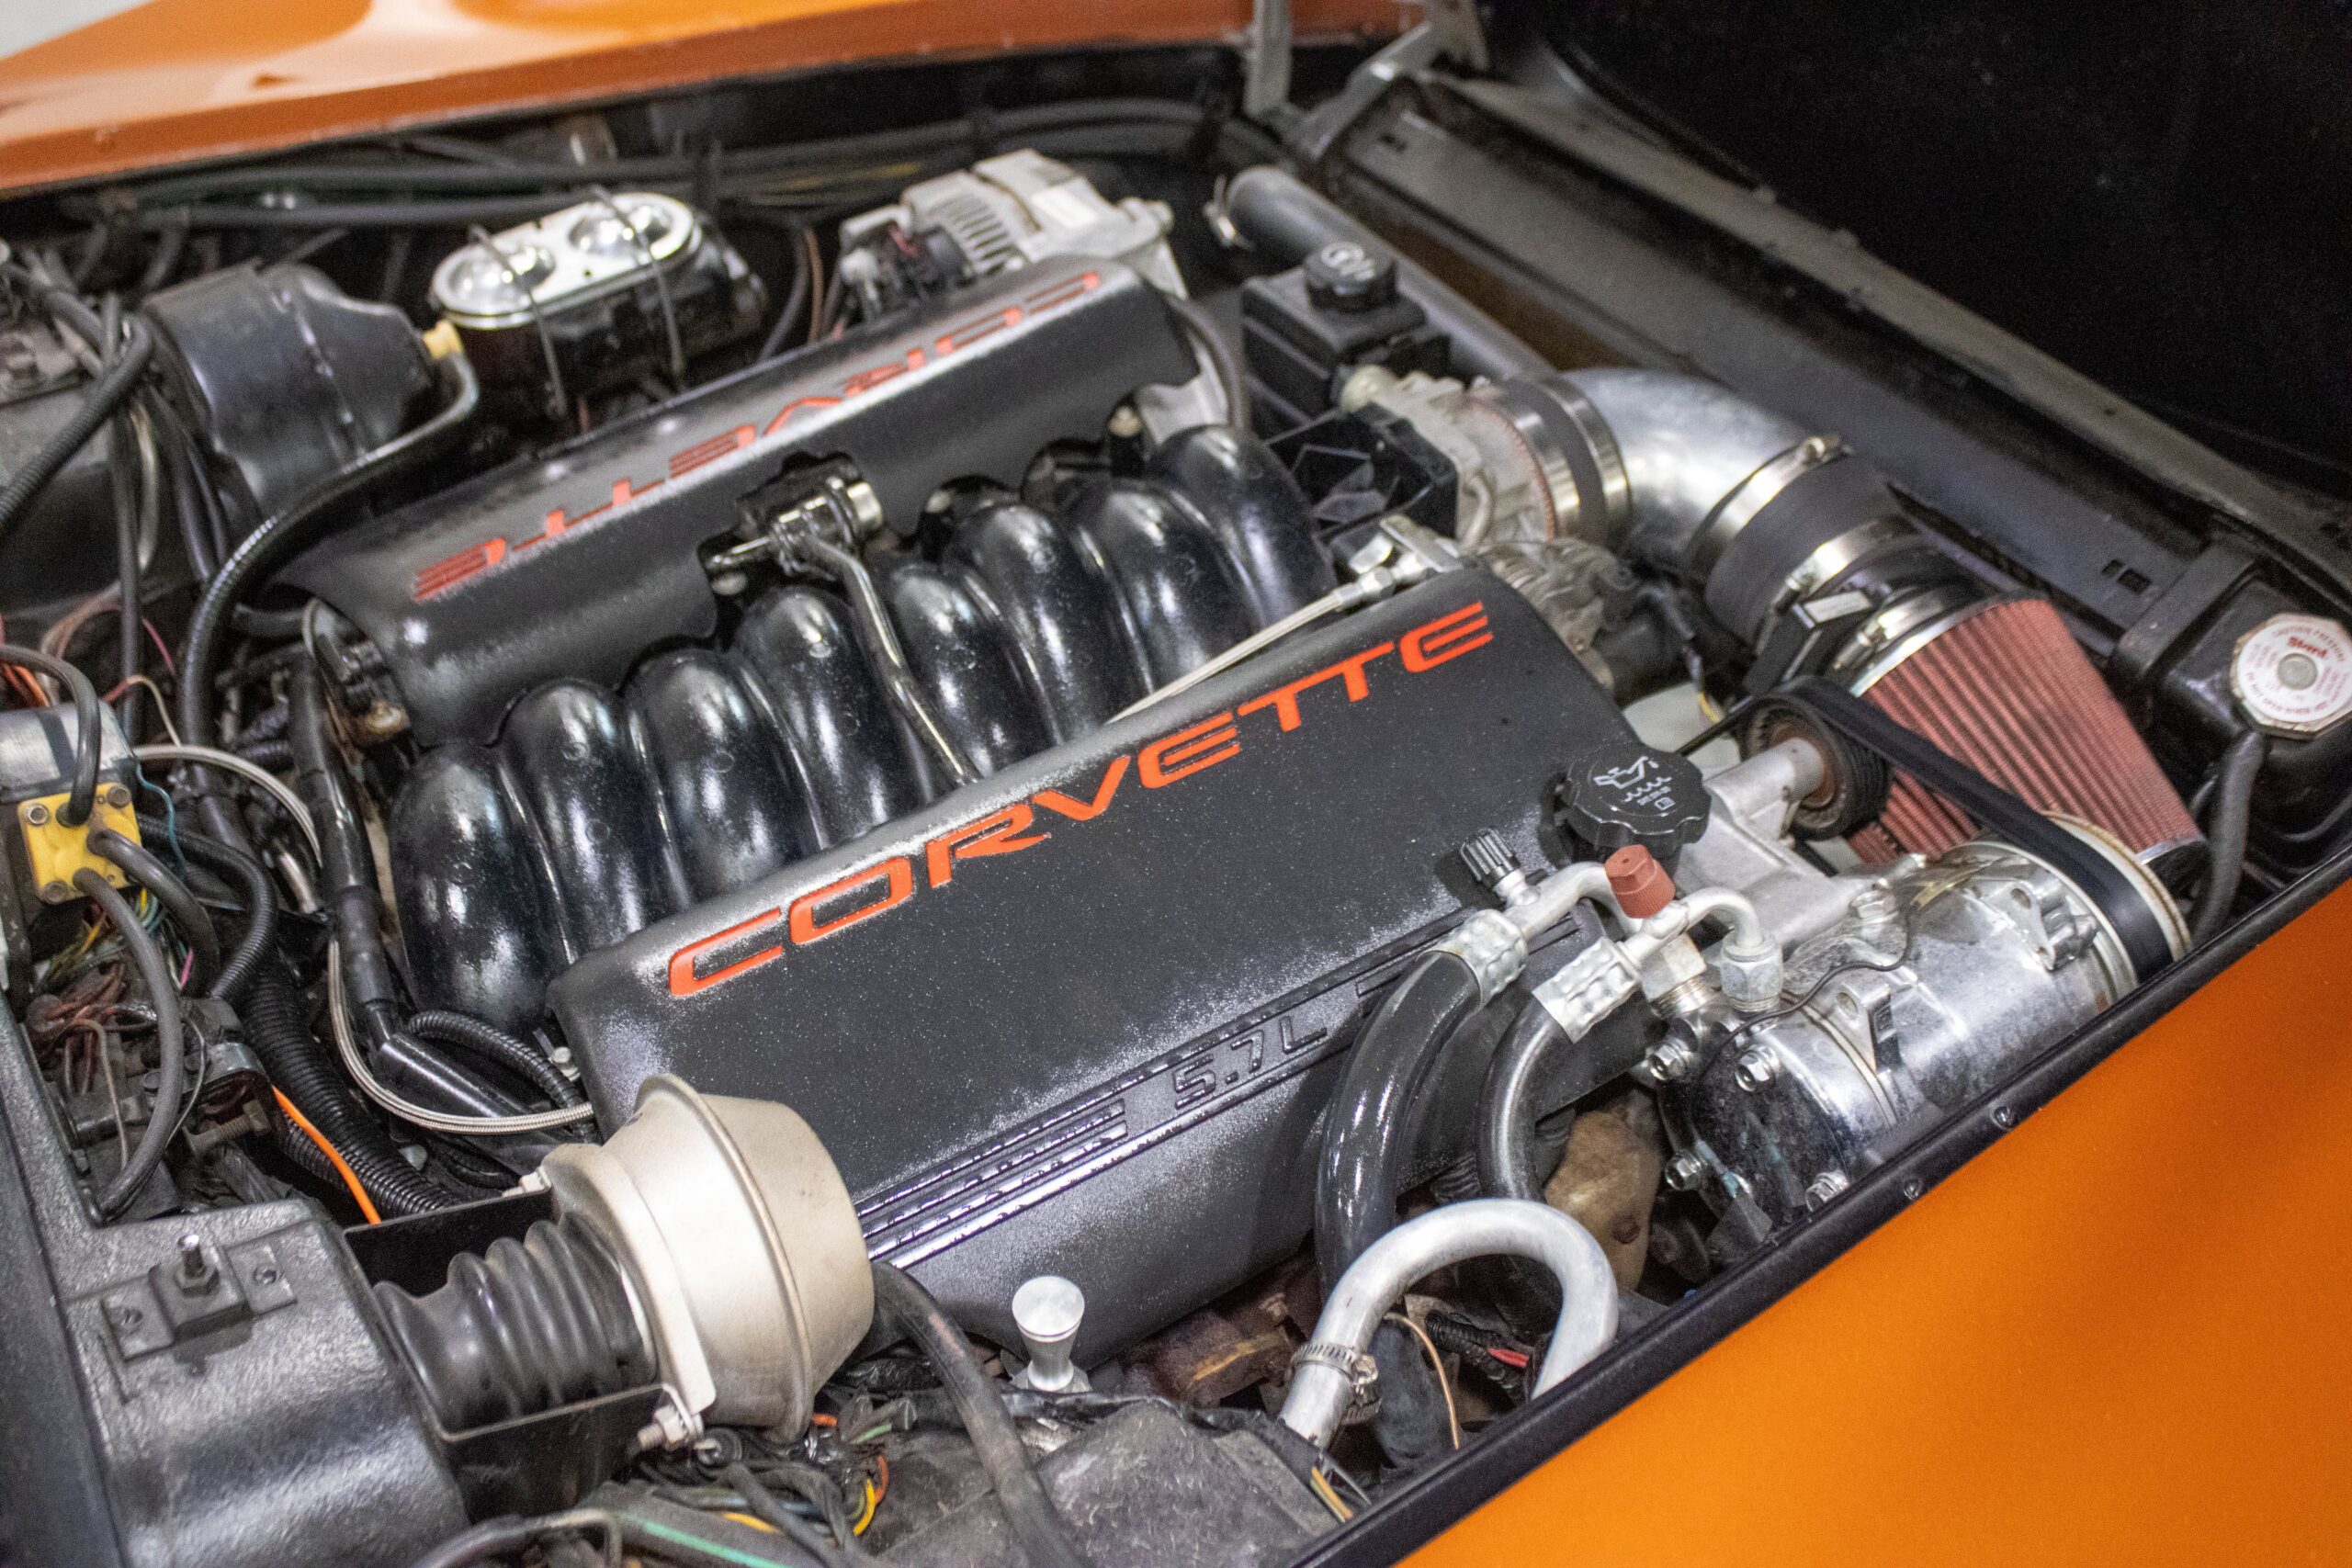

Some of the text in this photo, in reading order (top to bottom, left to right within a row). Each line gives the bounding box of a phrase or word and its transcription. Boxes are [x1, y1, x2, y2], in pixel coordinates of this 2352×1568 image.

[414, 271, 1100, 600] CORVETTE
[668, 601, 1494, 996] CORVETTE
[1172, 1015, 1328, 1110] 5.7L
